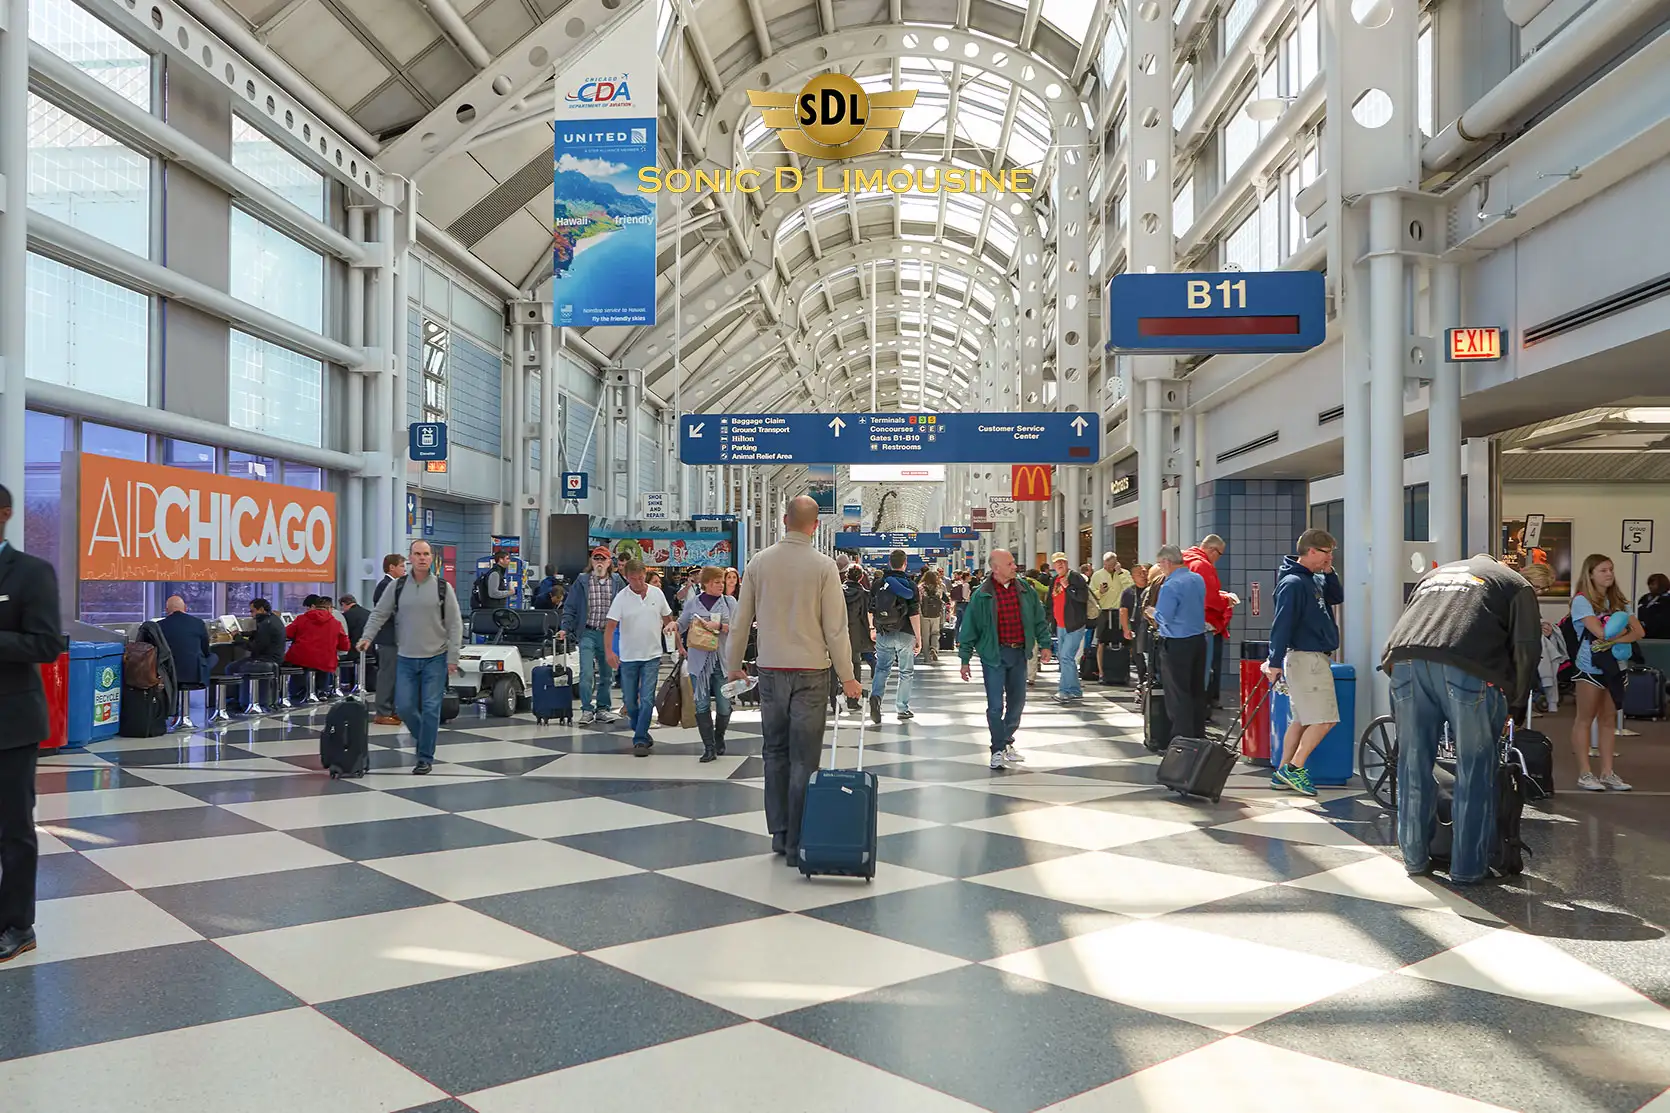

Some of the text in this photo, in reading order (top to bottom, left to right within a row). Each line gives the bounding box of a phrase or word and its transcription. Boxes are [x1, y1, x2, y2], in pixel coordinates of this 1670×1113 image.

[577, 81, 631, 102] CDA
[563, 132, 627, 143] UNITED
[615, 215, 654, 226] friendly
[1187, 279, 1247, 309] B11
[1454, 329, 1496, 352] EXIT
[758, 426, 790, 434] Transport
[1013, 432, 1040, 440] Center
[731, 444, 758, 452] Parking
[952, 526, 967, 534] B10
[1530, 527, 1537, 538] 4
[1633, 532, 1642, 543] 5
[96, 692, 120, 703] RECYCLE
